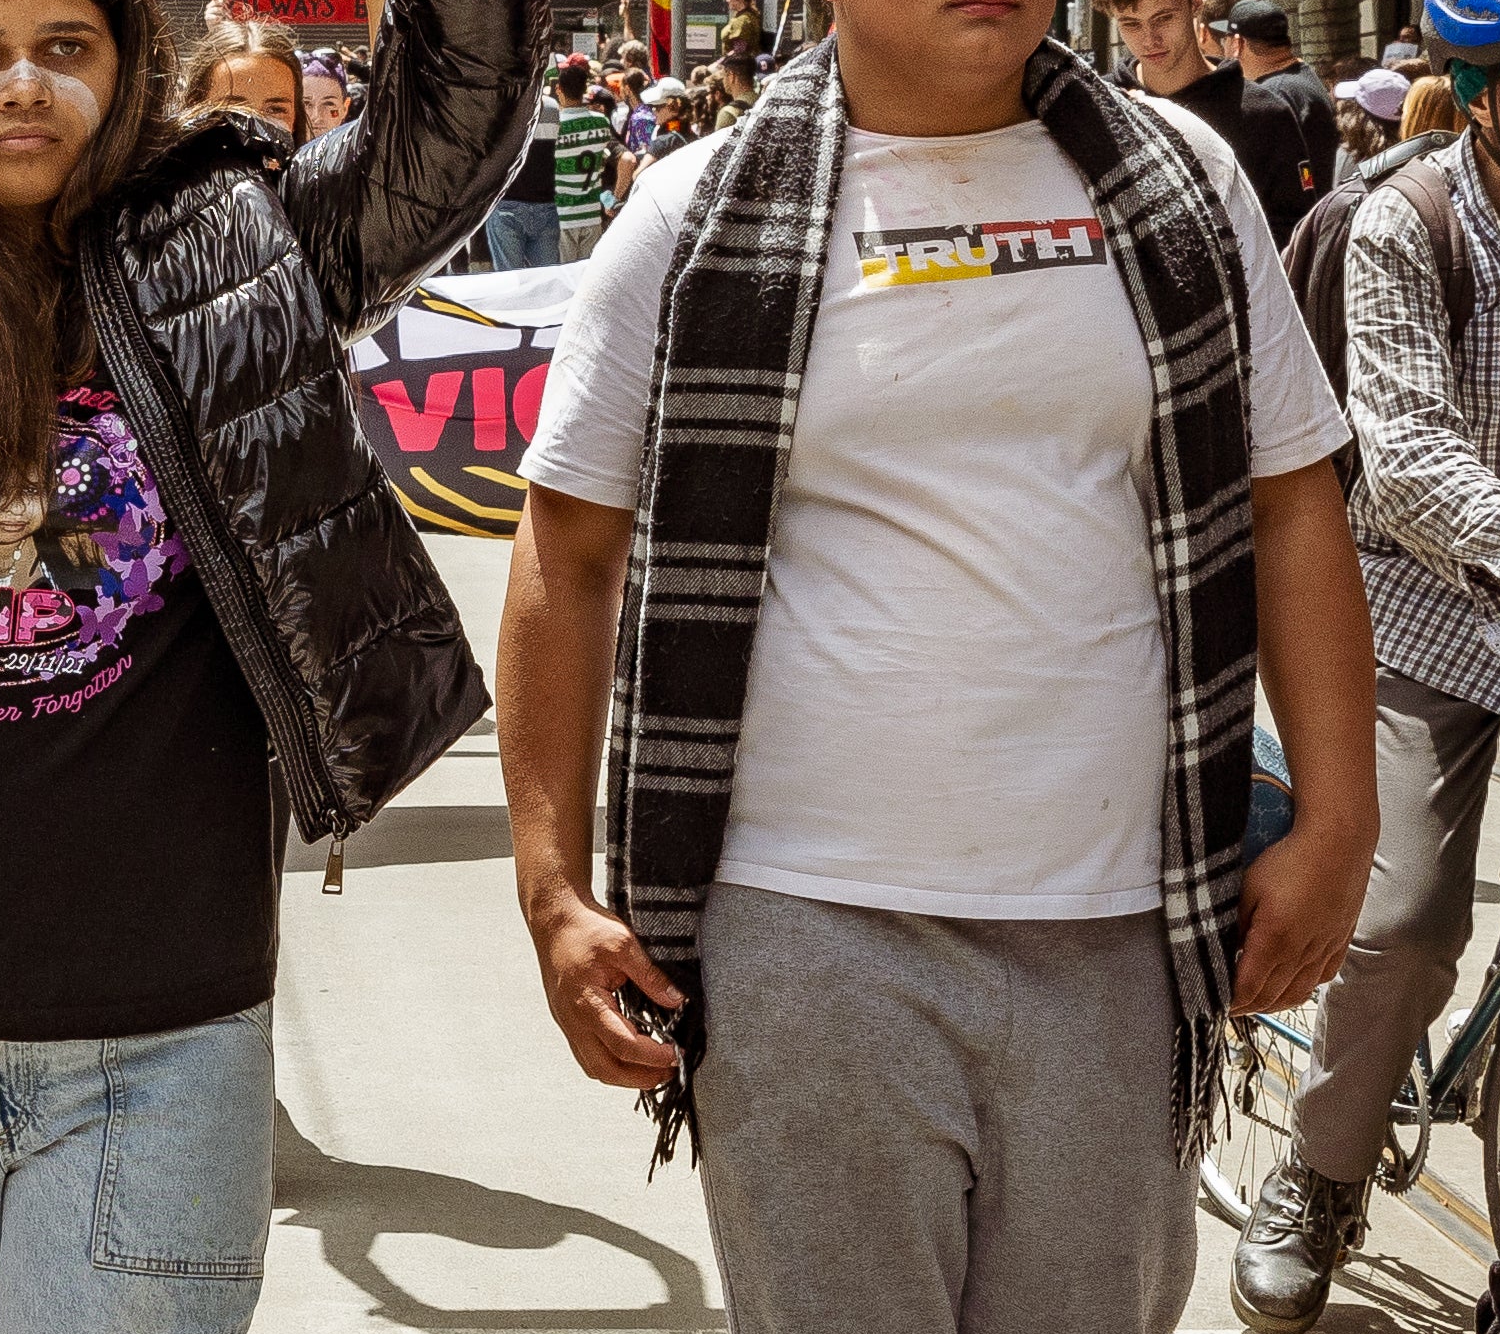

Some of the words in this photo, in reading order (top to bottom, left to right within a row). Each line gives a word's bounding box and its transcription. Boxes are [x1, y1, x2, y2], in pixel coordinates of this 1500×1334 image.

[578, 150, 596, 191] 9
[874, 226, 1094, 274] TRUTH
[5, 652, 88, 675] 29/11/21
[32, 654, 133, 719] Forgotten
